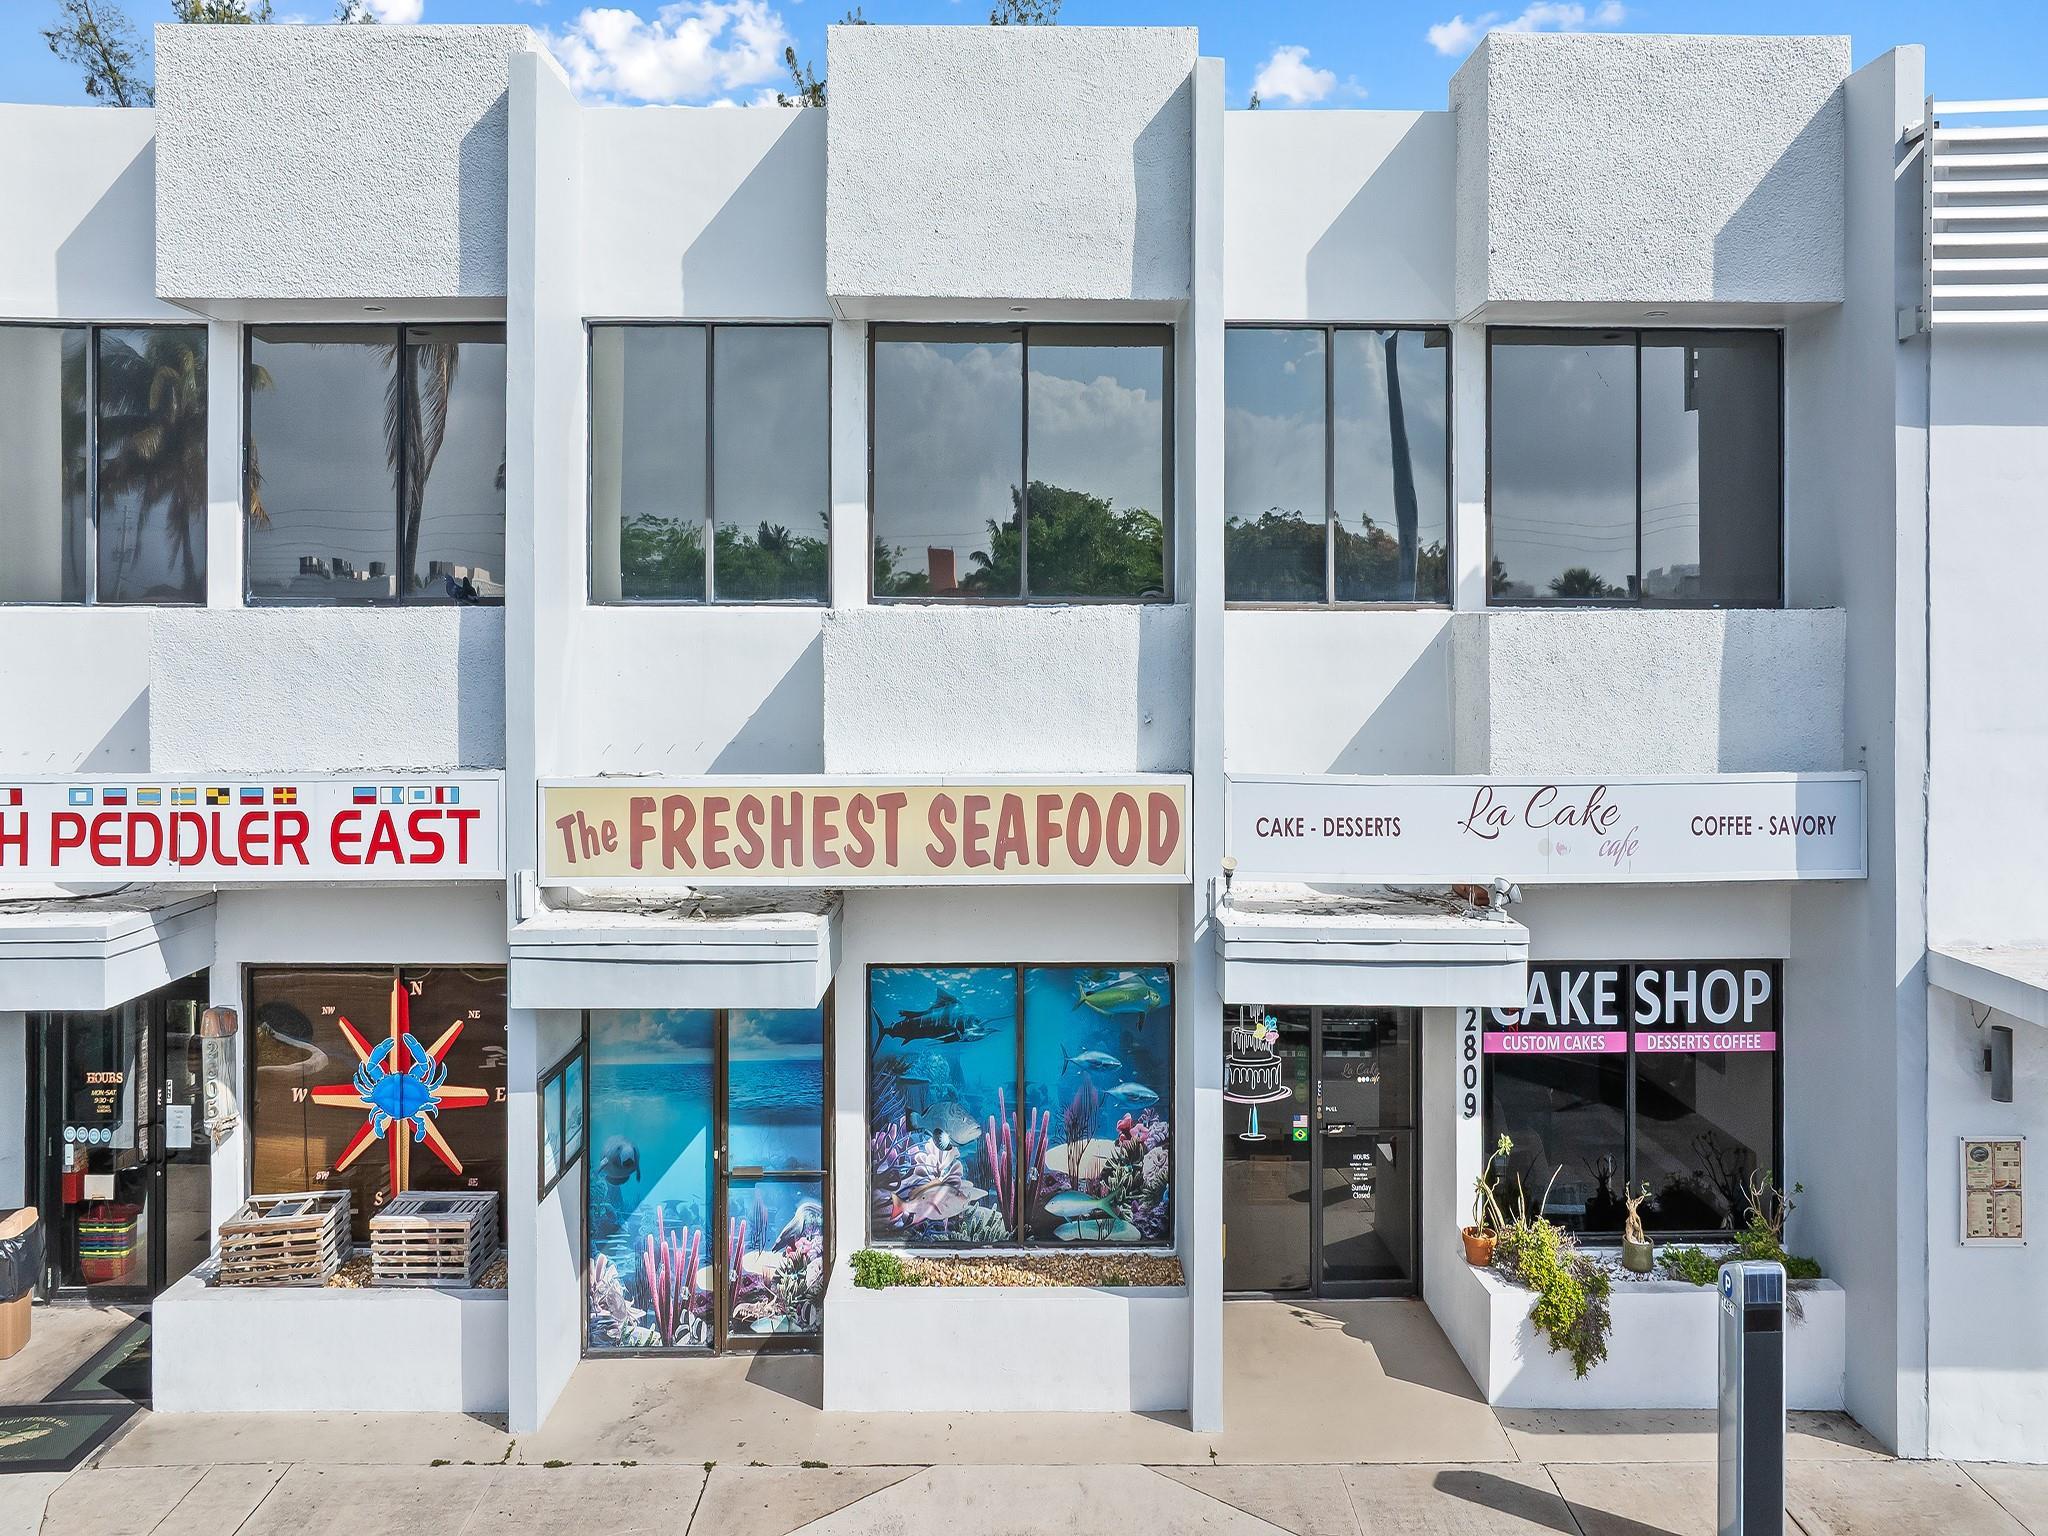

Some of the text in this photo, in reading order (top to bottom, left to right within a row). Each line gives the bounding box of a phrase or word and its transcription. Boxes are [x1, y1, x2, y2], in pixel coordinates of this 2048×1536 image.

[1457, 784, 1622, 840] La Cake
[555, 791, 1181, 870] The FRESHEST SEAFOOD
[1255, 816, 1304, 838] CAKE
[1323, 816, 1401, 837] DESSERTS
[1691, 815, 1752, 836] COFFEE
[1769, 815, 1837, 836] SAVORY
[0, 809, 481, 867] H PEDDLER EAST
[409, 980, 424, 996] N
[1634, 969, 1771, 1025] SHOP
[321, 1006, 336, 1016] NW
[468, 1010, 481, 1019] NE
[1502, 1034, 1606, 1051] CUSTOM CAKES
[1647, 1033, 1761, 1050] DESSERTS COFFEE
[1463, 1008, 1478, 1119] 2809
[86, 1071, 124, 1084] HOURS
[291, 1087, 308, 1103] W
[494, 1087, 507, 1103] E
[1351, 1183, 1372, 1193] Sunday
[1352, 1191, 1371, 1199] Closed
[374, 1191, 384, 1206] S
